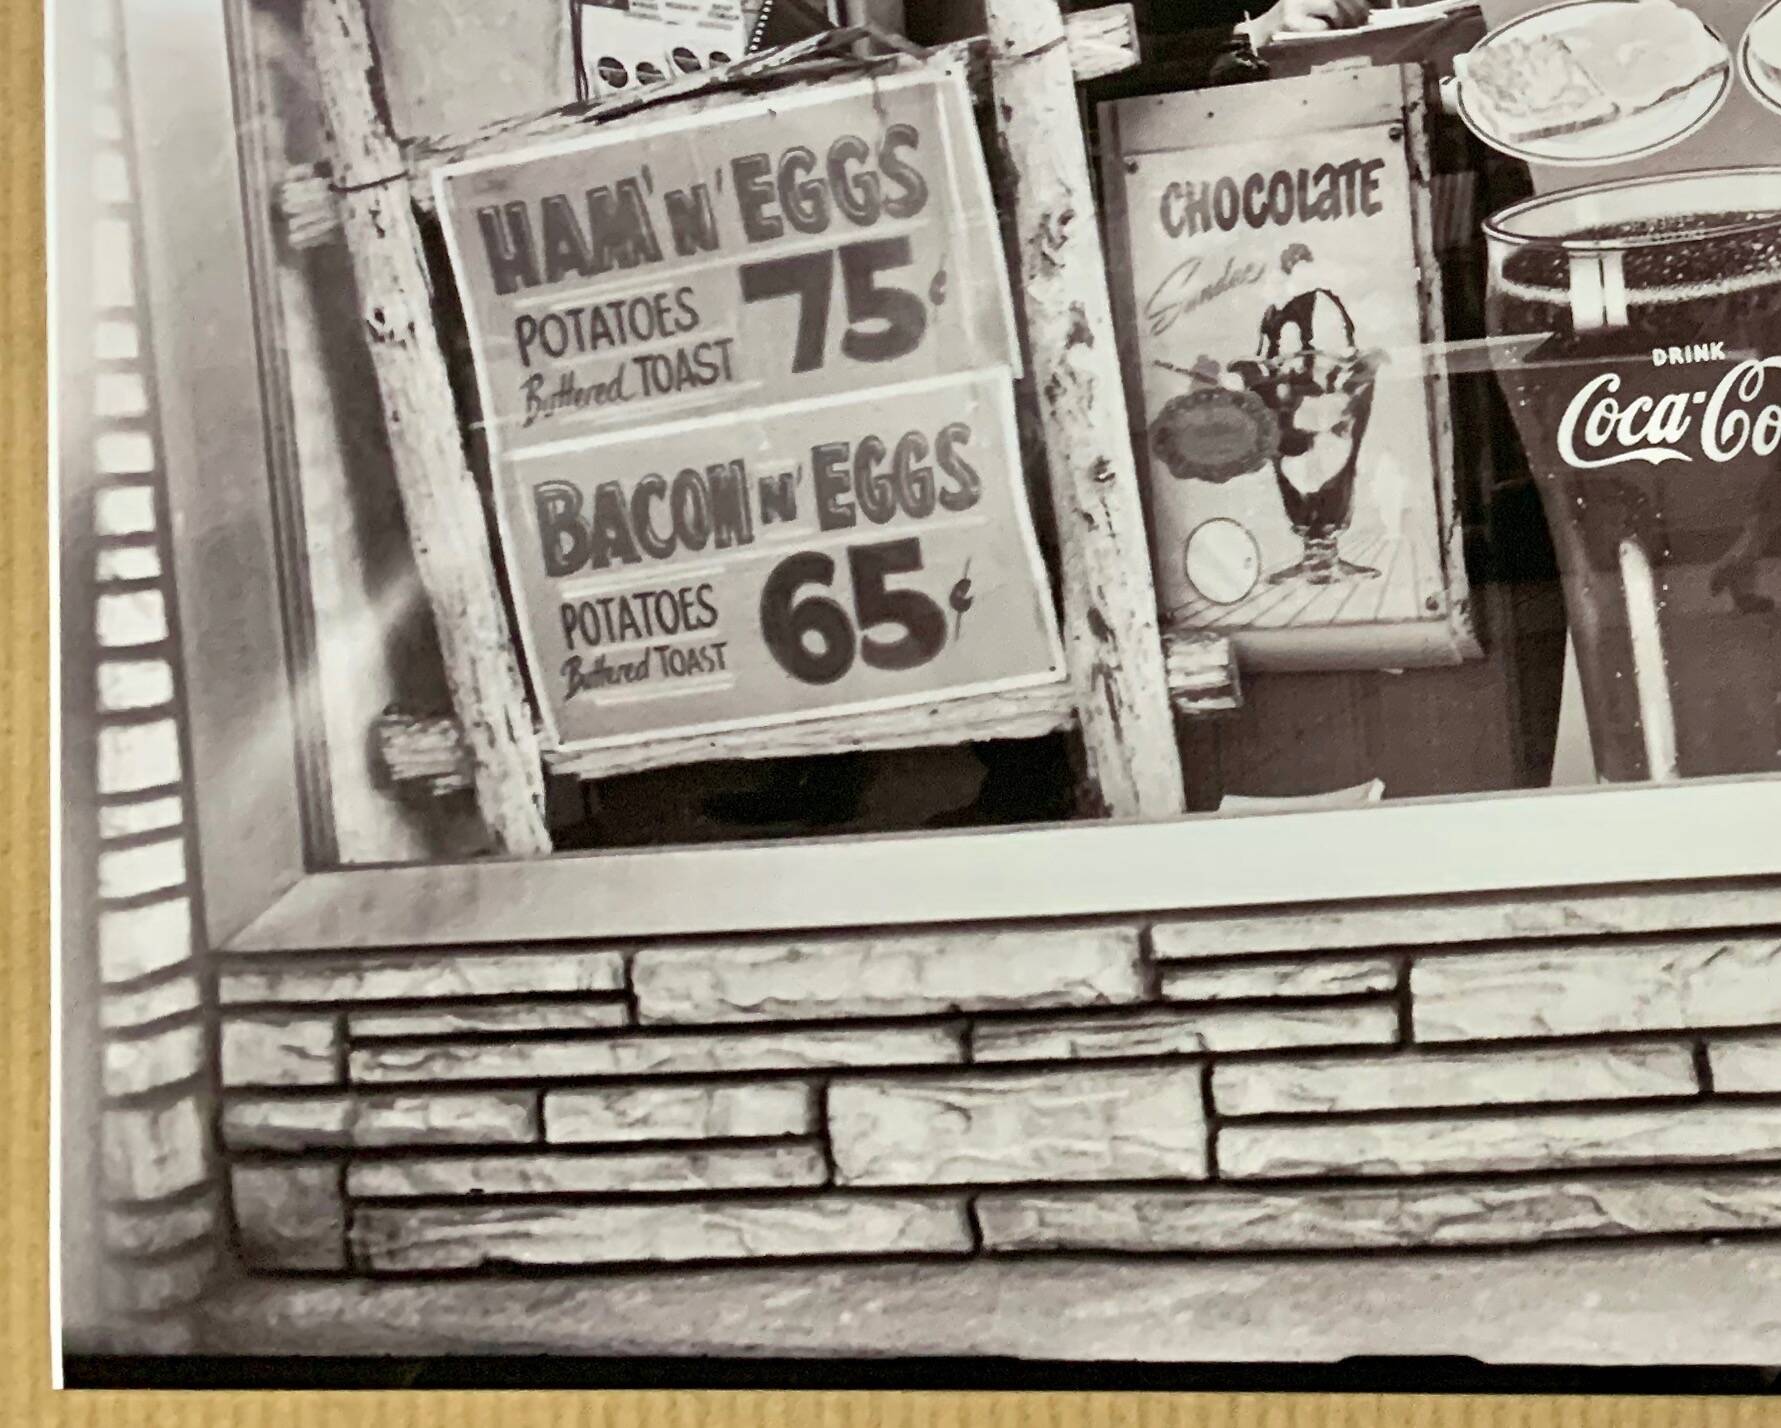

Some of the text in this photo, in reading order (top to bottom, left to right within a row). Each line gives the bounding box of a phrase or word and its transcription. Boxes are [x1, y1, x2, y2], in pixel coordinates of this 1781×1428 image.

[731, 123, 929, 243] EGGS
[515, 286, 700, 367] POTATOES
[1652, 341, 1727, 366] DRINK
[520, 337, 734, 428] Buttered TOAST
[533, 458, 755, 577] BACON
[811, 422, 981, 532] EGGS
[560, 537, 974, 685] POTATOES 65¢
[560, 641, 728, 702] Buttered TOAST
